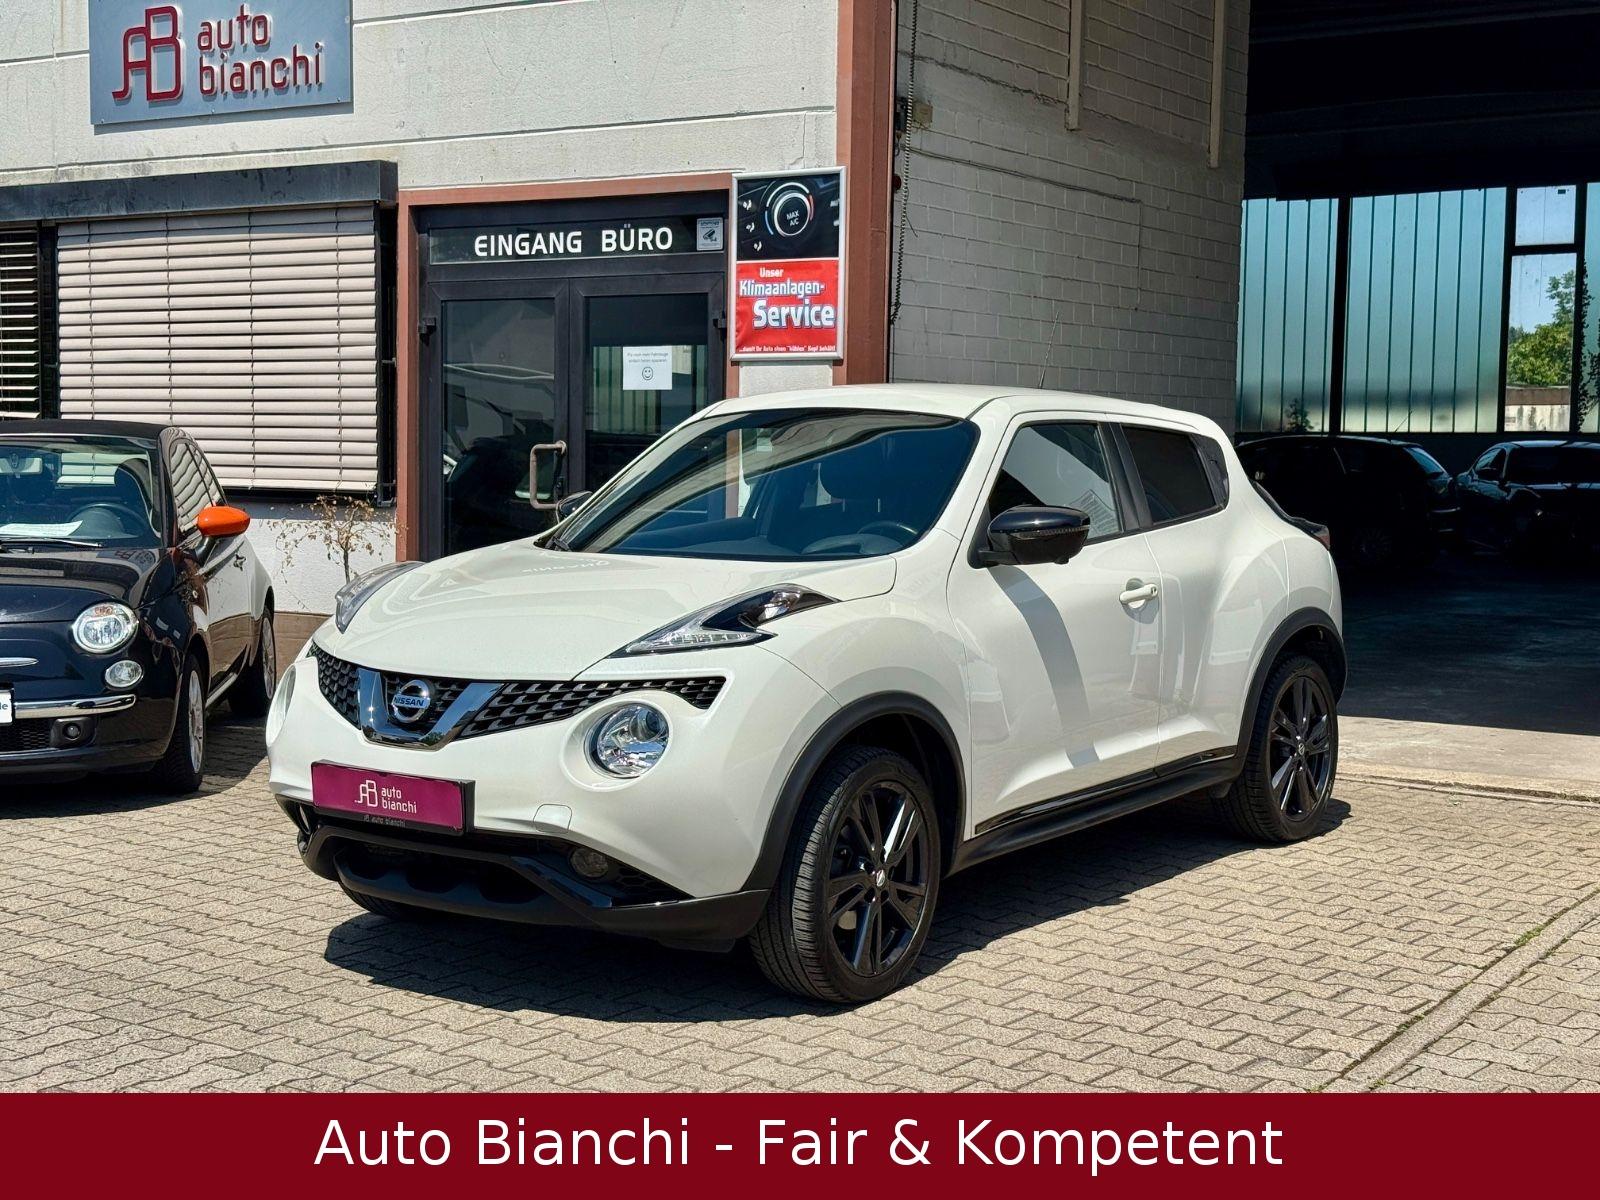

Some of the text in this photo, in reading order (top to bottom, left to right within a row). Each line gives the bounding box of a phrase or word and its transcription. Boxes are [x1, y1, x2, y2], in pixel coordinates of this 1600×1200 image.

[197, 3, 271, 51] auto
[200, 41, 322, 96] bianchi
[474, 223, 673, 257] EINGANG BÜRO
[759, 267, 784, 278] Unser
[739, 278, 825, 299] Klimaanlagen-
[753, 298, 835, 328] Service
[394, 696, 425, 707] NISSAN
[381, 786, 402, 799] auto
[382, 797, 417, 814] bianchi
